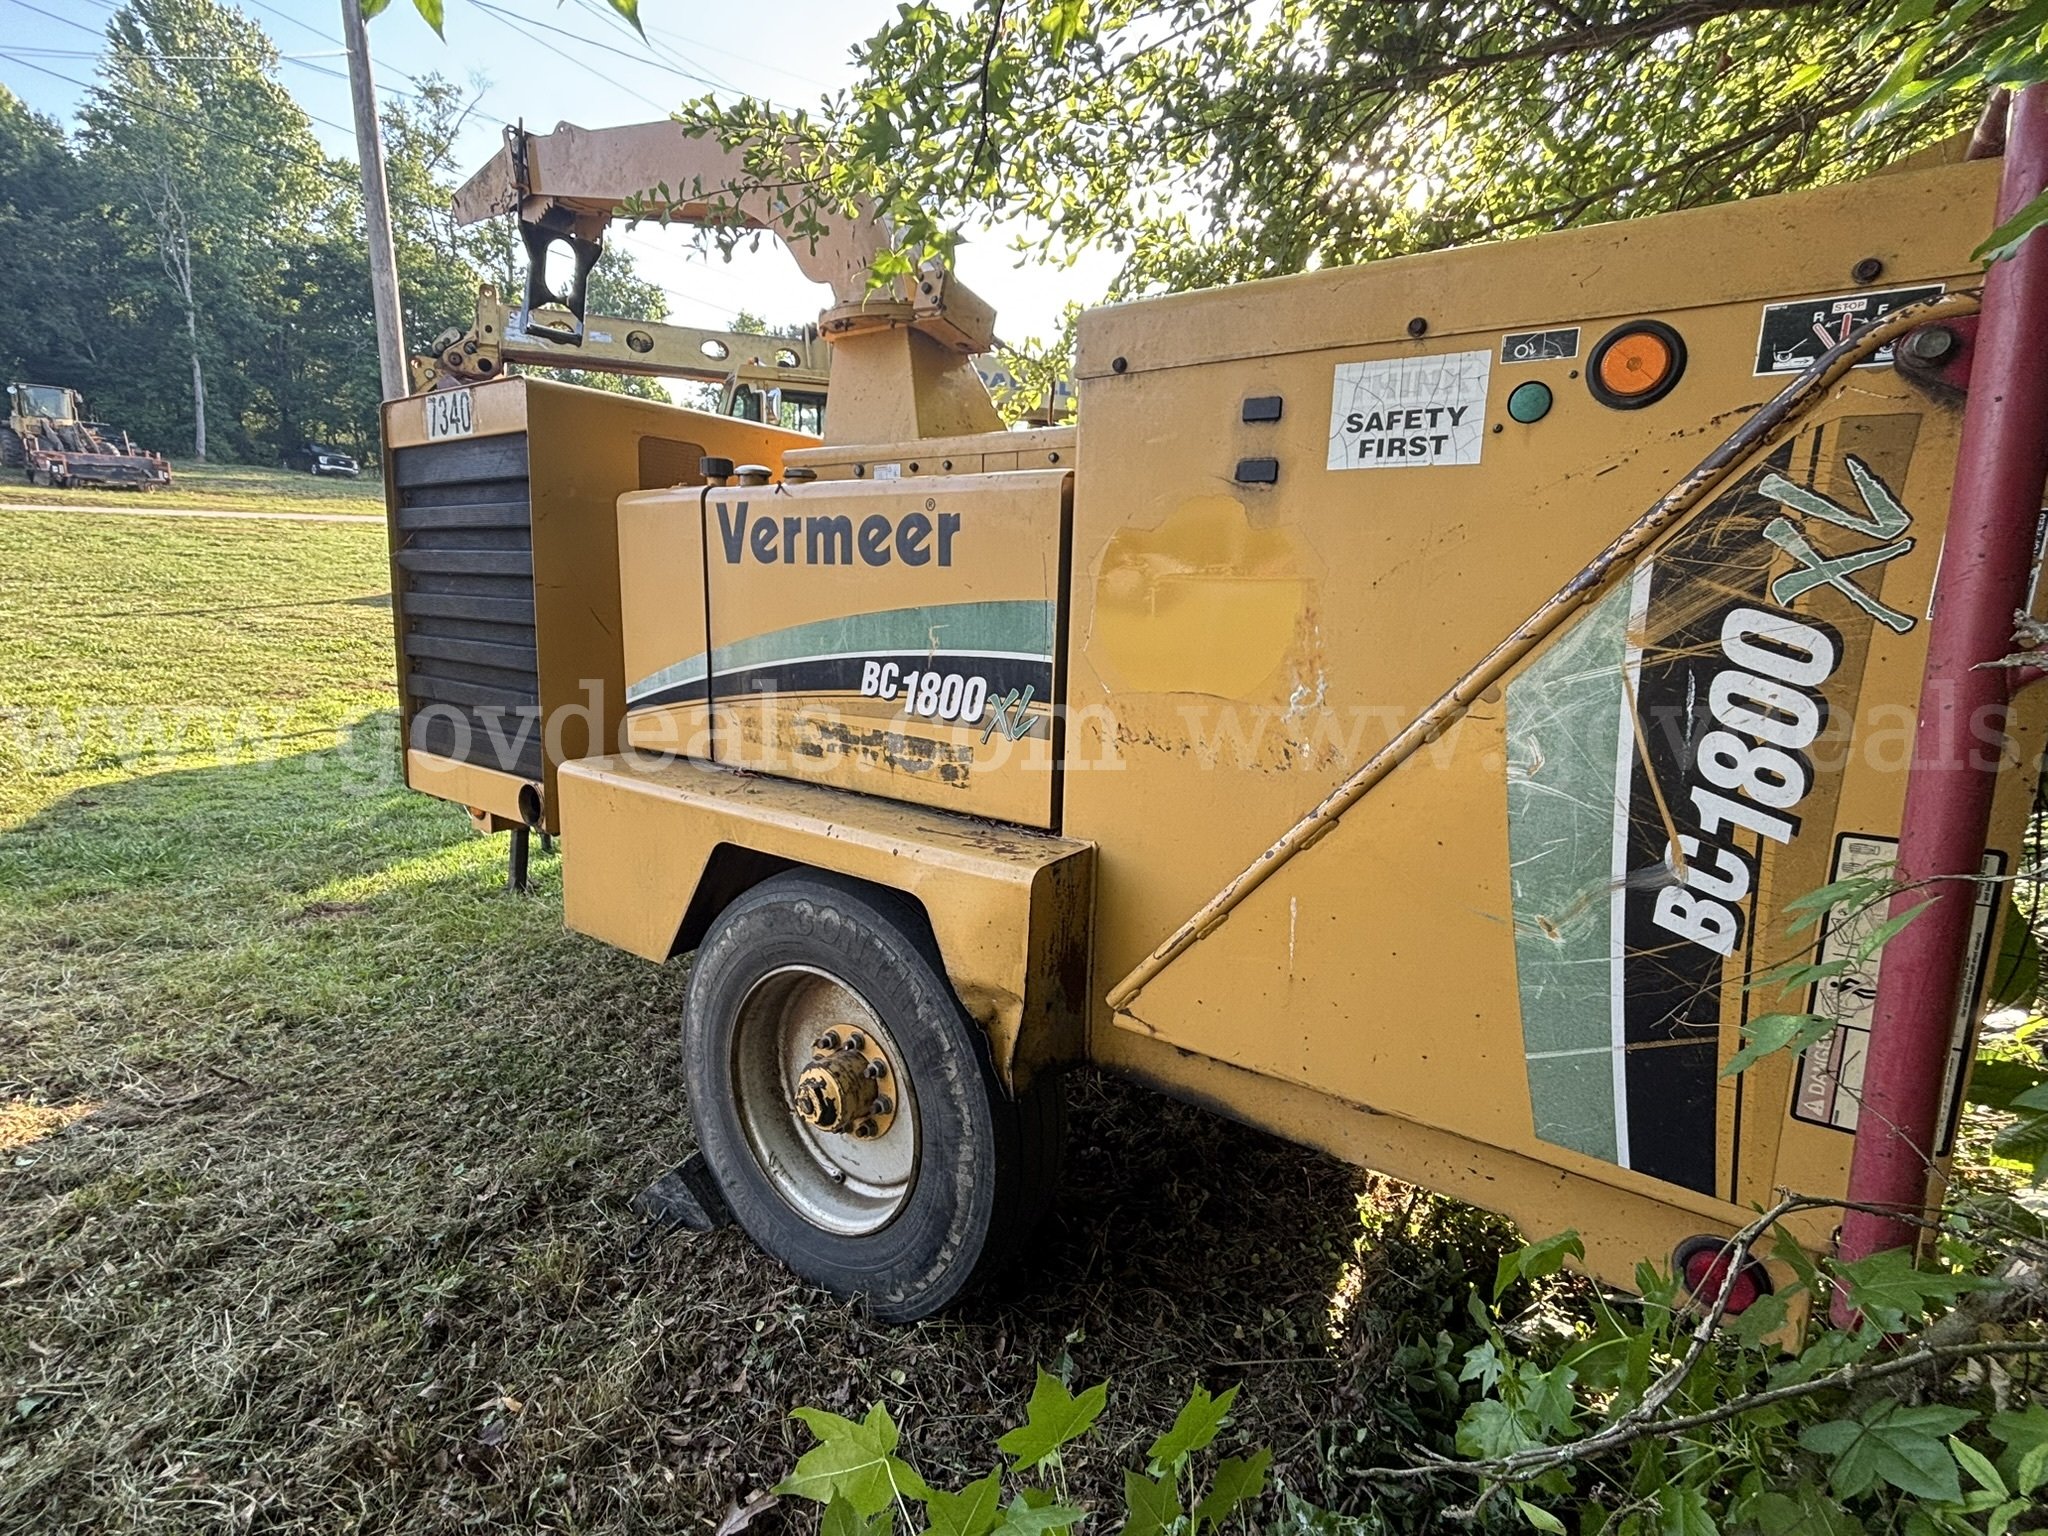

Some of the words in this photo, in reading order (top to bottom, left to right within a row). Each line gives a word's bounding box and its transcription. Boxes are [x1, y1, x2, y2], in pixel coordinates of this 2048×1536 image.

[1834, 301, 1866, 313] STOP
[1878, 304, 1889, 315] F
[1813, 312, 1825, 323] R
[1345, 405, 1469, 434] SAFETY
[1358, 434, 1449, 459] FIRST
